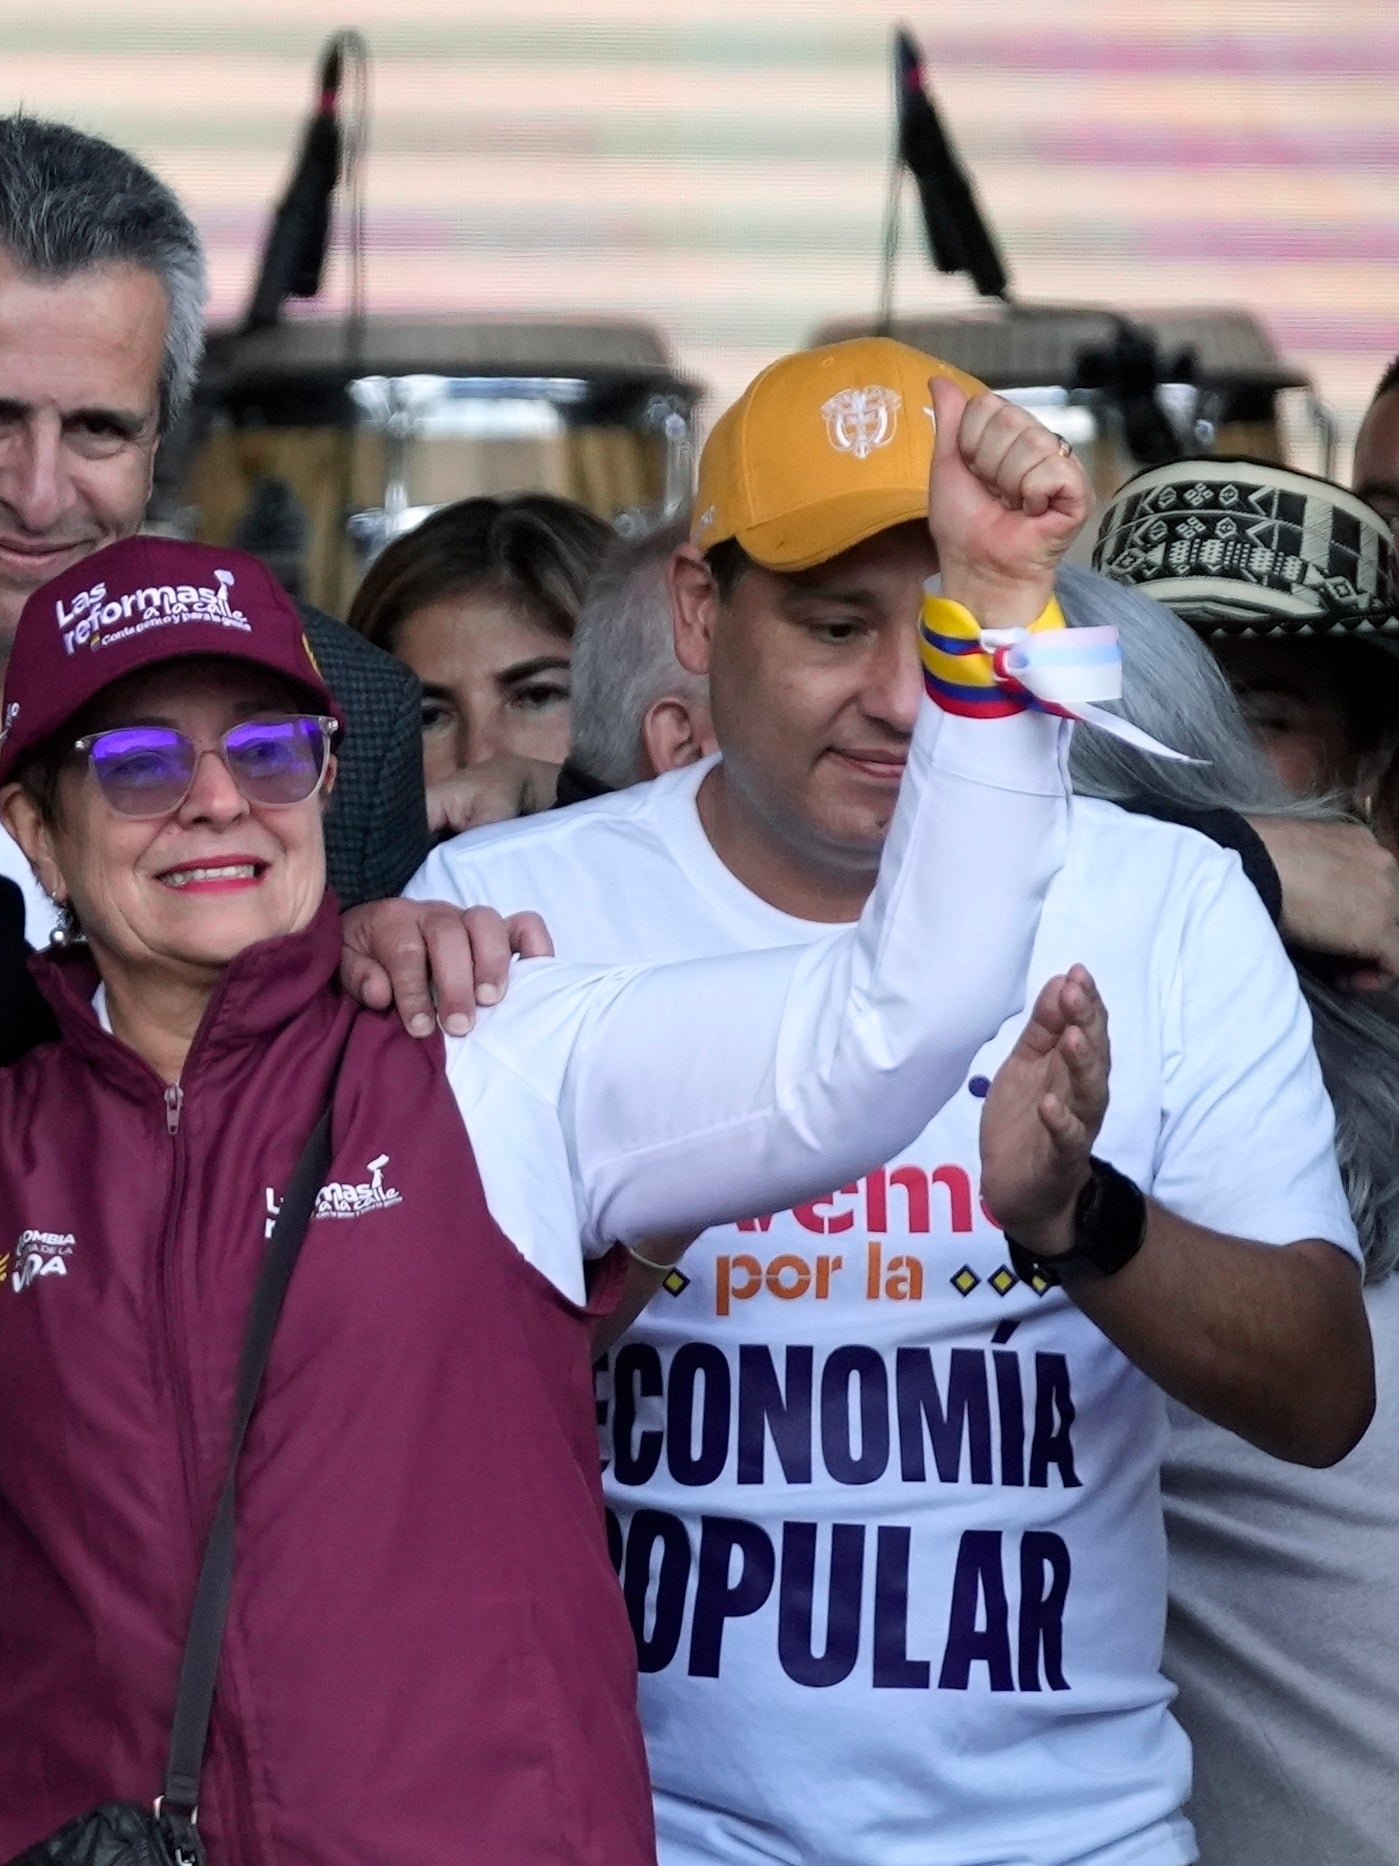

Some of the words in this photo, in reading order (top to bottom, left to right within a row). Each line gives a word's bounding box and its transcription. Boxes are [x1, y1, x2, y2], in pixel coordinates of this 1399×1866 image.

[56, 582, 108, 629] Las
[63, 585, 218, 656] reformas
[143, 606, 159, 621] a
[164, 595, 188, 615] la
[193, 600, 248, 622] calle
[715, 1253, 843, 1317] por
[867, 1241, 924, 1301] la
